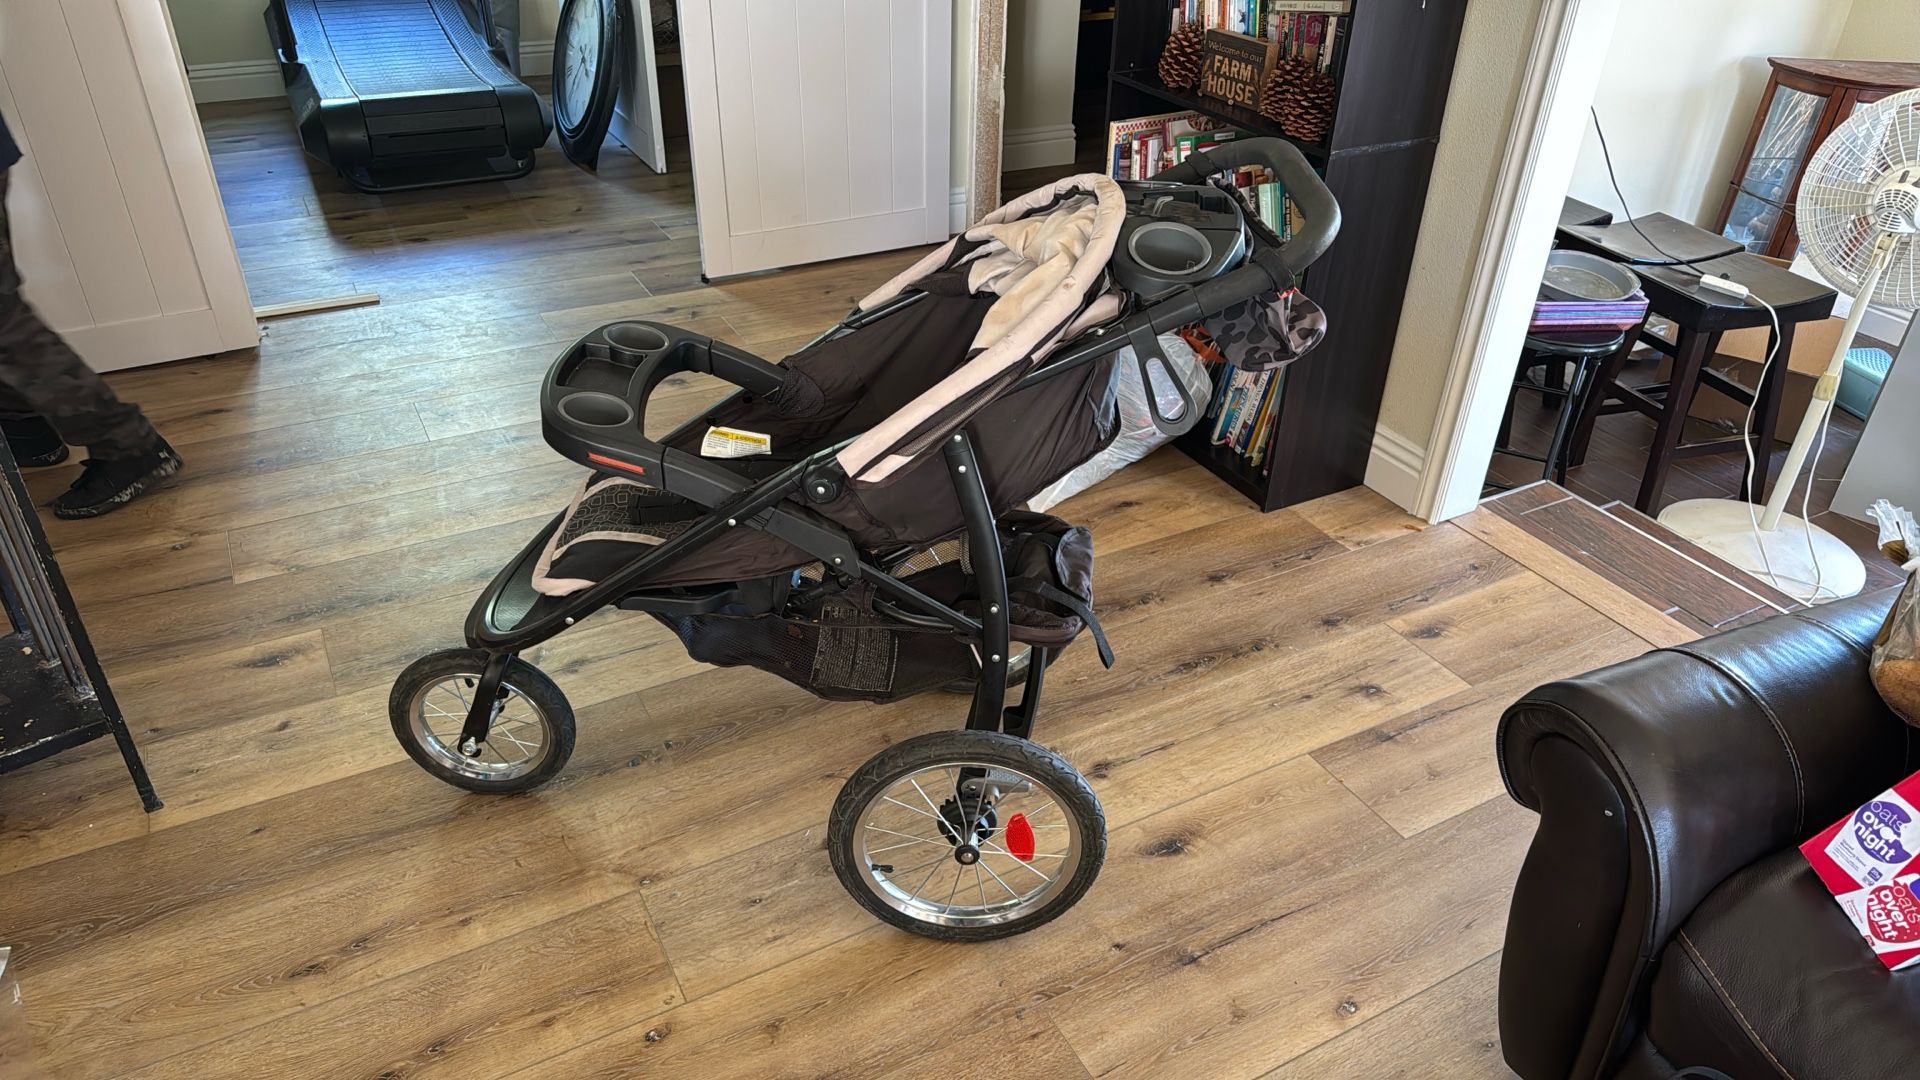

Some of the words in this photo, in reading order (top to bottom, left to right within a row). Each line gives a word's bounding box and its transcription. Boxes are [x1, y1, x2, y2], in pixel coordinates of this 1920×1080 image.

[1208, 40, 1240, 56] Welcome
[1241, 50, 1249, 59] to
[1250, 54, 1264, 63] our
[1213, 54, 1252, 83] FARM
[1207, 73, 1255, 105] HOUSE
[1862, 811, 1900, 844] ovr
[1870, 801, 1904, 833] oats
[1854, 821, 1896, 862] night
[1867, 894, 1899, 939] night
[1880, 889, 1910, 929] over
[1893, 885, 1920, 924] oats
